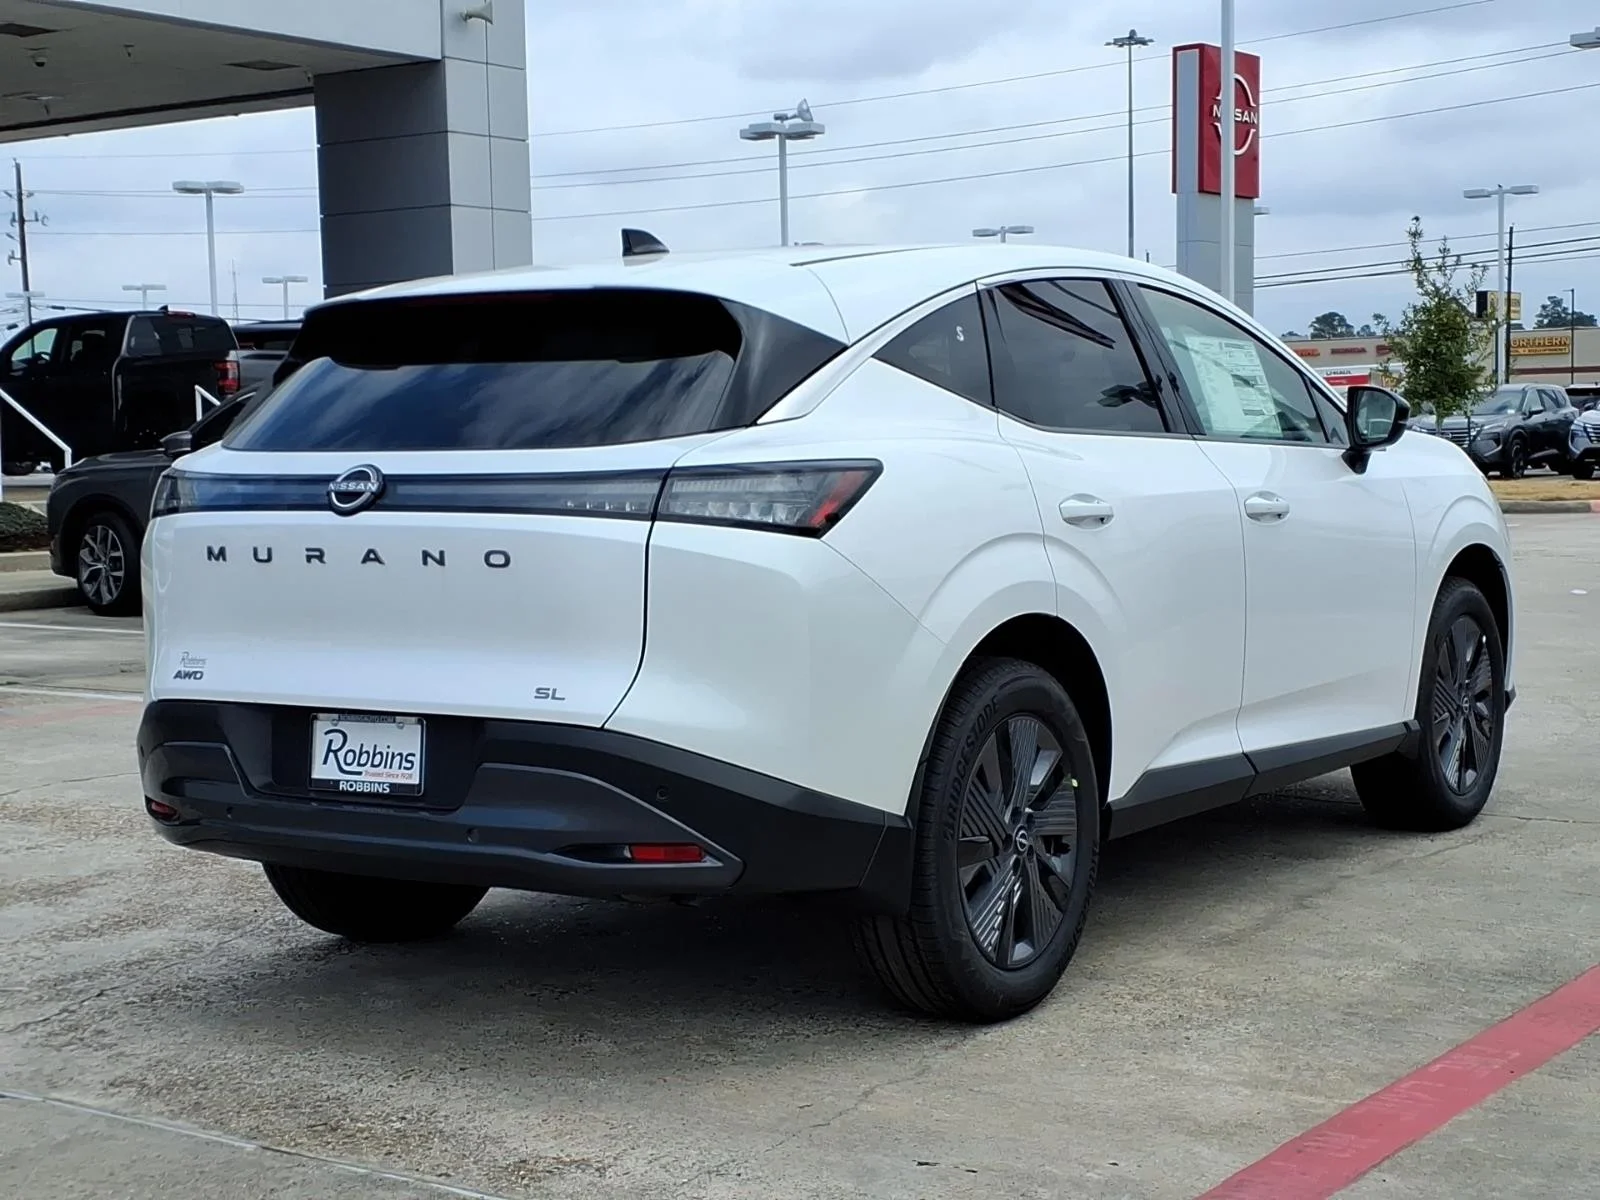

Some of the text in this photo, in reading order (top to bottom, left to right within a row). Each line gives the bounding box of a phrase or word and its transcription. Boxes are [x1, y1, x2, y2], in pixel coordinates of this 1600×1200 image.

[1212, 104, 1258, 125] NSAN
[1511, 336, 1570, 348] ORTHERN
[328, 482, 378, 492] NISSAN
[206, 545, 511, 568] MURANO
[173, 670, 204, 680] AWD
[534, 687, 566, 701] SL
[322, 728, 416, 776] Robbins
[339, 780, 390, 793] ROBBINS
